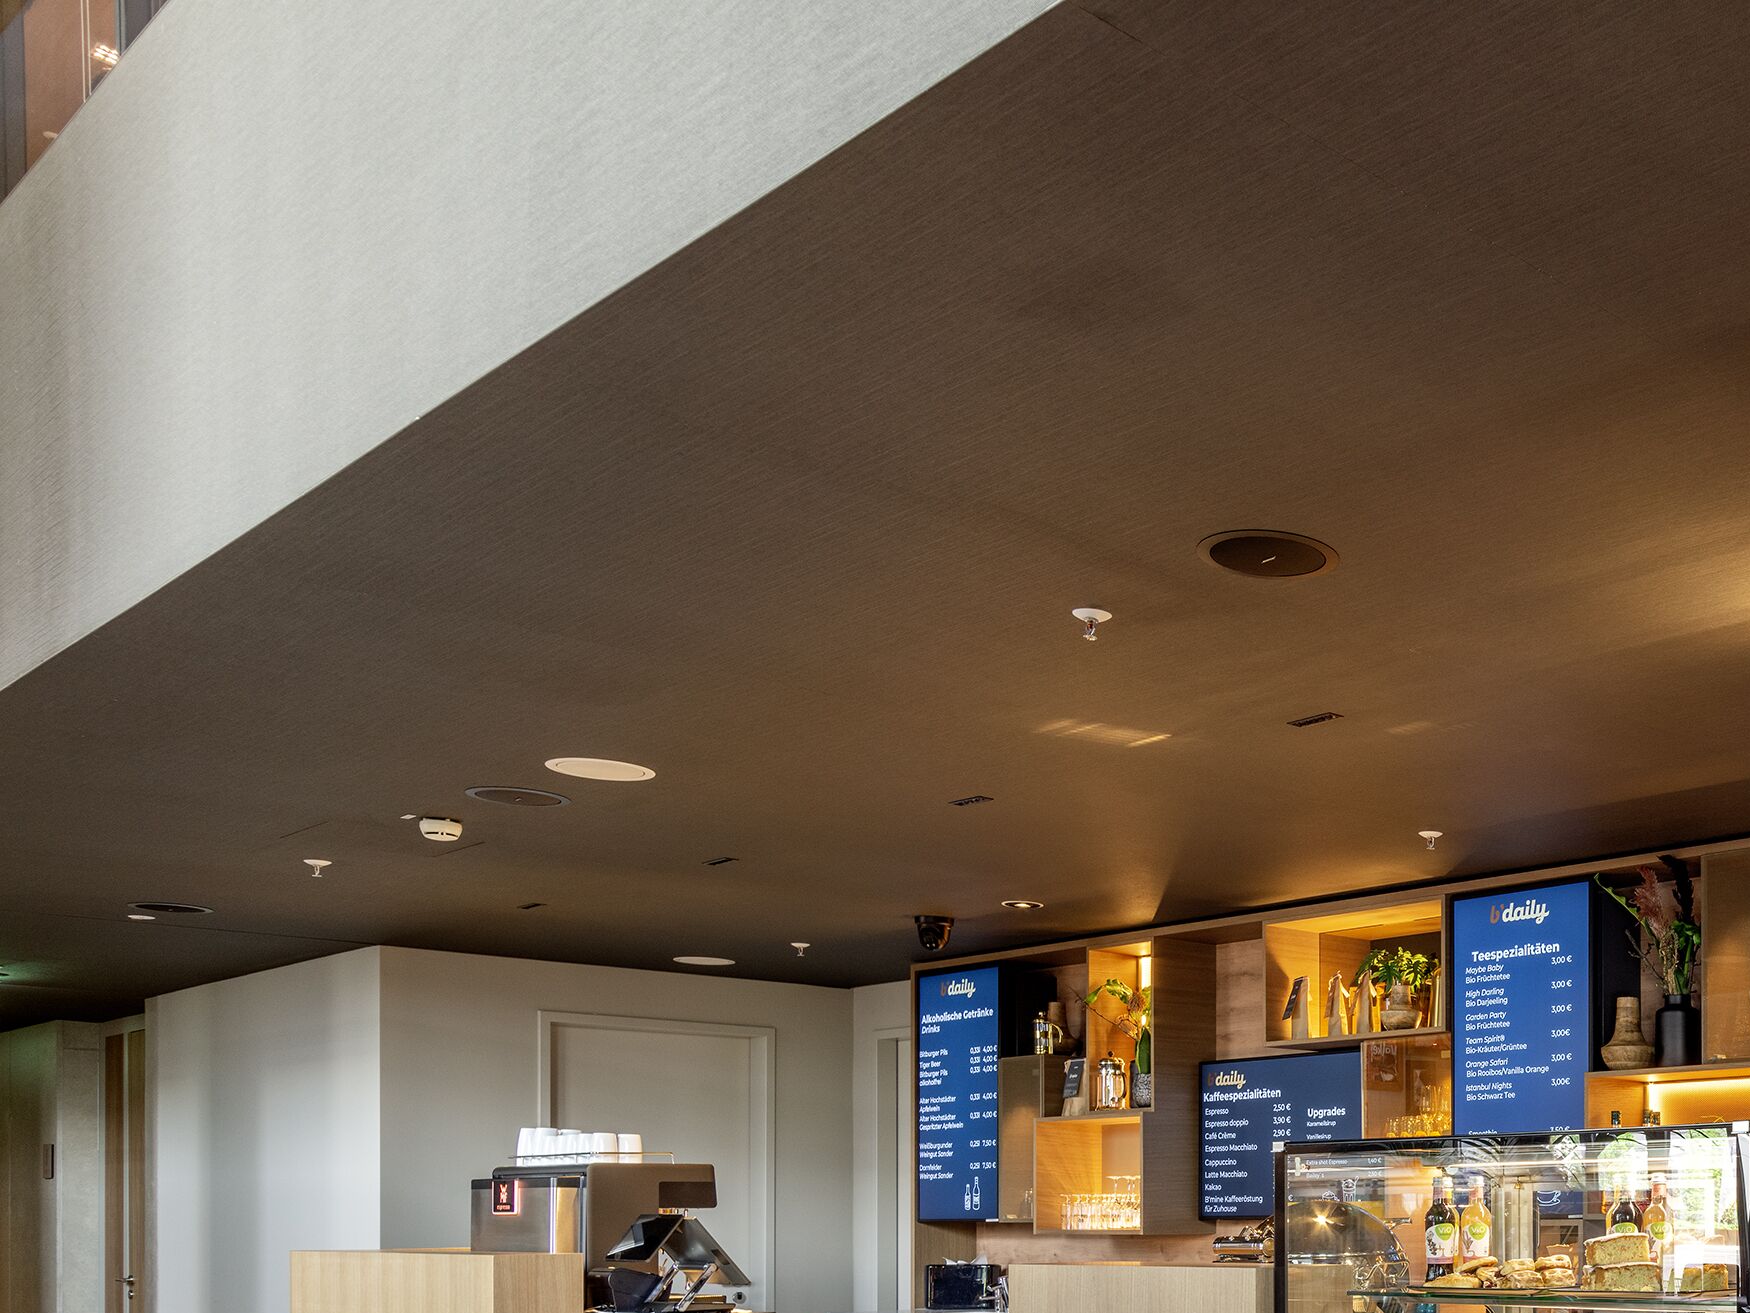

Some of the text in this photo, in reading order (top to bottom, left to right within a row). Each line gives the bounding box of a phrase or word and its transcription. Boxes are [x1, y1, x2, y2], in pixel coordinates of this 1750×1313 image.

[1490, 899, 1550, 924] b'daily
[1472, 942, 1560, 962] Teespezialitäten
[1465, 955, 1572, 975] Maybe Baby 3,00 €
[1465, 973, 1511, 984] Bio Früchtetee
[1465, 990, 1480, 999] High
[1481, 987, 1505, 996] Darling
[1551, 981, 1565, 989] 3,00
[1476, 997, 1508, 1006] Darjeeling
[921, 1007, 994, 1024] Alkoholische Getränke
[1465, 1004, 1572, 1021] Garden Party 3,00 €
[921, 1025, 941, 1034] Drinks
[1465, 1020, 1511, 1031] Bio Früchtetee
[1466, 1037, 1483, 1045] Team
[1465, 1043, 1528, 1055] Bio-Kräuter/Grüntee
[1466, 1060, 1488, 1069] Orange
[1490, 1058, 1508, 1067] Safari
[1551, 1054, 1565, 1062] 3,00
[1466, 1065, 1549, 1078] Bio Rooibos/Vanilla Orange
[1466, 1083, 1491, 1092] Istanbul
[1491, 1082, 1513, 1091] Nights
[1203, 1088, 1281, 1102] Kaffeespezialitäten
[1466, 1091, 1515, 1101] Bio Schwarz Tee
[1205, 1103, 1292, 1116] Espresso 2,50 €
[1307, 1106, 1346, 1119] Upgrades
[1205, 1120, 1228, 1129] Espresso
[1229, 1118, 1249, 1127] doppio
[1273, 1116, 1285, 1125] 3,90
[1205, 1132, 1217, 1140] Café
[1218, 1131, 1236, 1140] Crème
[1273, 1129, 1285, 1138] 2,90
[1205, 1143, 1258, 1153] Espresso Macchiato
[1205, 1158, 1237, 1167] Cappuccino
[1205, 1170, 1248, 1179] Latte Macchiato
[1205, 1183, 1222, 1191] Kakao
[1205, 1194, 1263, 1204] B'mine Kaffeeröstung
